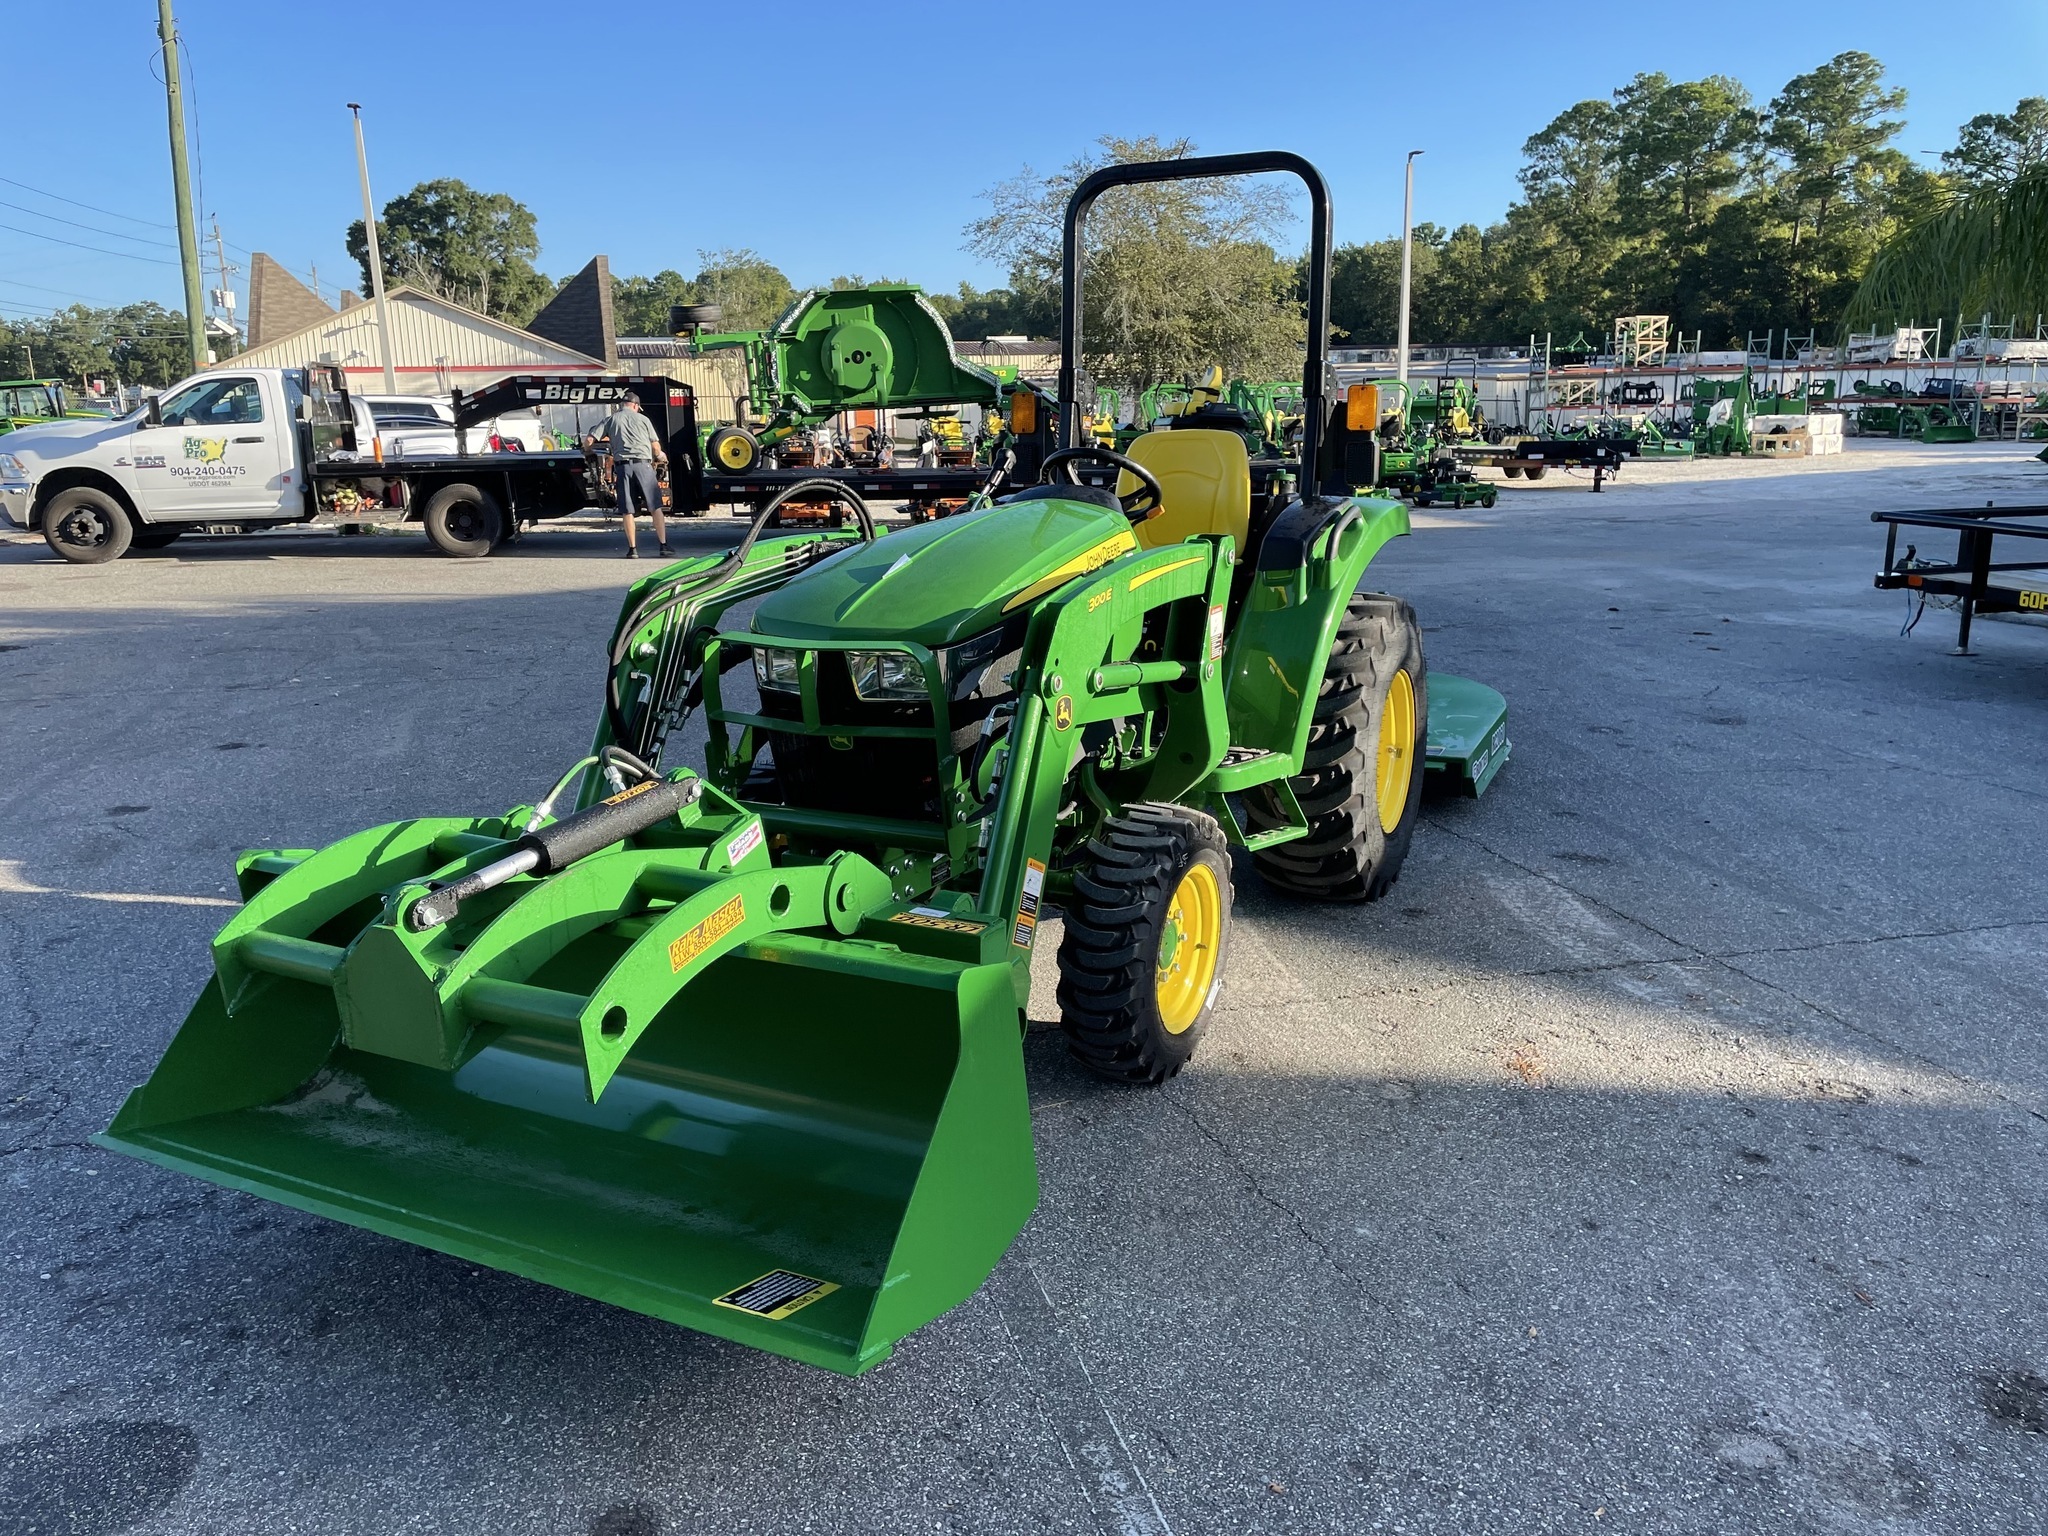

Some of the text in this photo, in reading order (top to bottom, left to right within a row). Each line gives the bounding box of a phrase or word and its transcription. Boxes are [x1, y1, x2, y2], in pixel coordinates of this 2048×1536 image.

[544, 384, 629, 403] BigTex
[669, 388, 690, 397] 226N
[184, 437, 206, 449] Ag-
[185, 447, 207, 458] Pro
[170, 466, 246, 476] 904-240-0475
[1086, 541, 1121, 571] JOHN DEERE
[672, 928, 700, 957] Rake
[702, 899, 742, 935] Master
